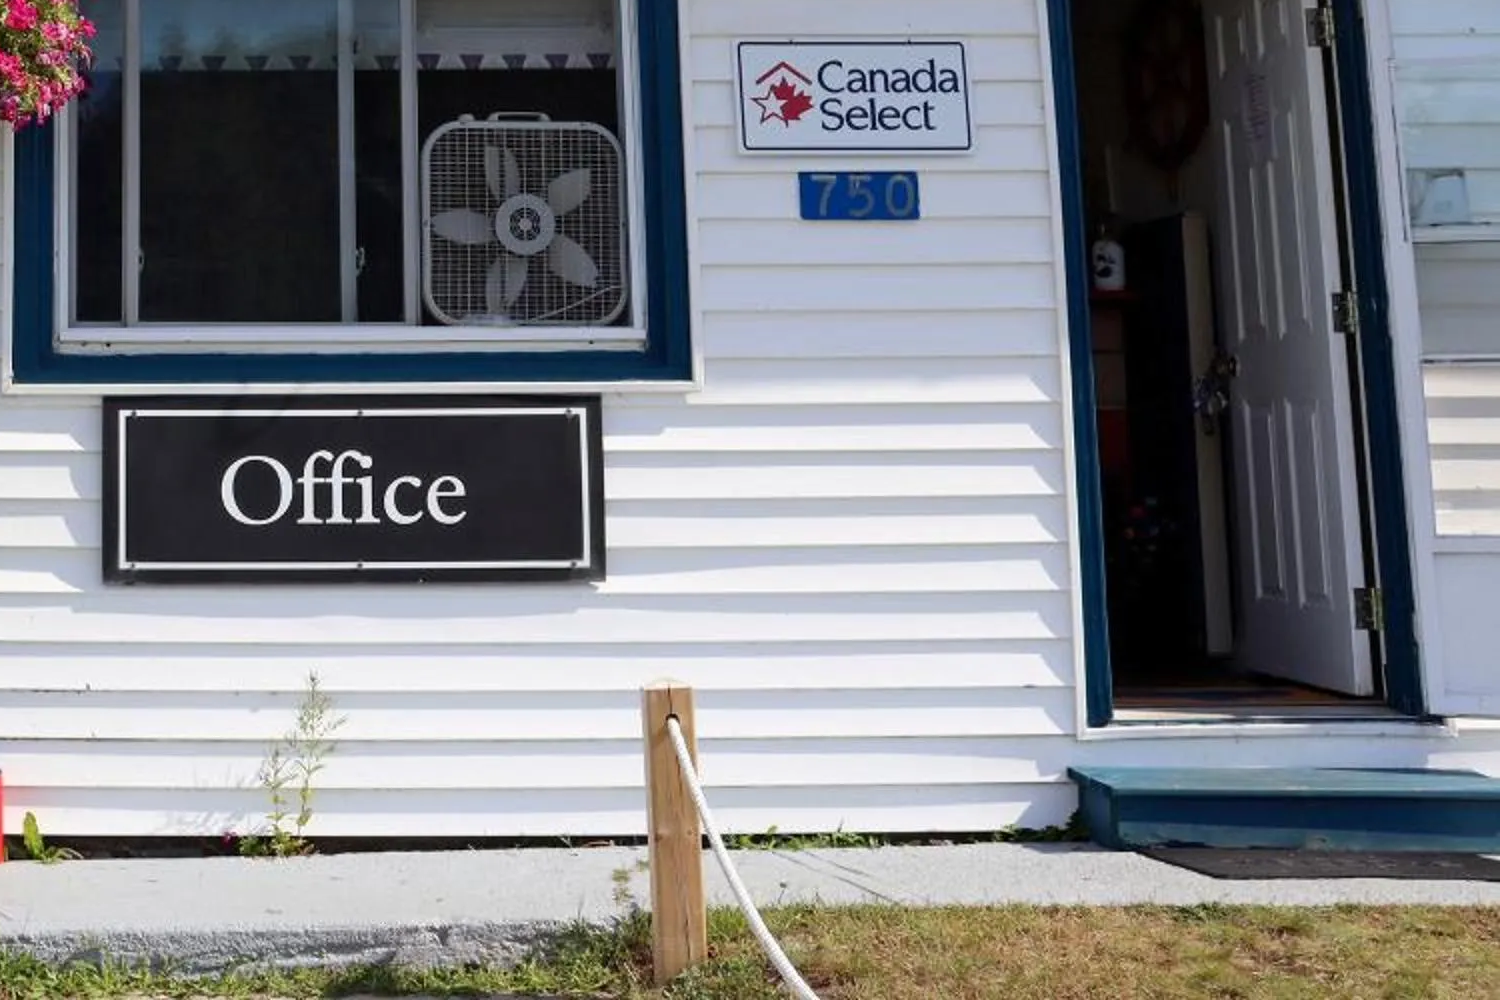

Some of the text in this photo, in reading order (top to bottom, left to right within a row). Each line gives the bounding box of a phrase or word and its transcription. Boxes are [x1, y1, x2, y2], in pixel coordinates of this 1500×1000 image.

[817, 58, 960, 94] Canada
[819, 98, 936, 131] Select
[809, 174, 915, 218] 750
[220, 449, 467, 526] Office
